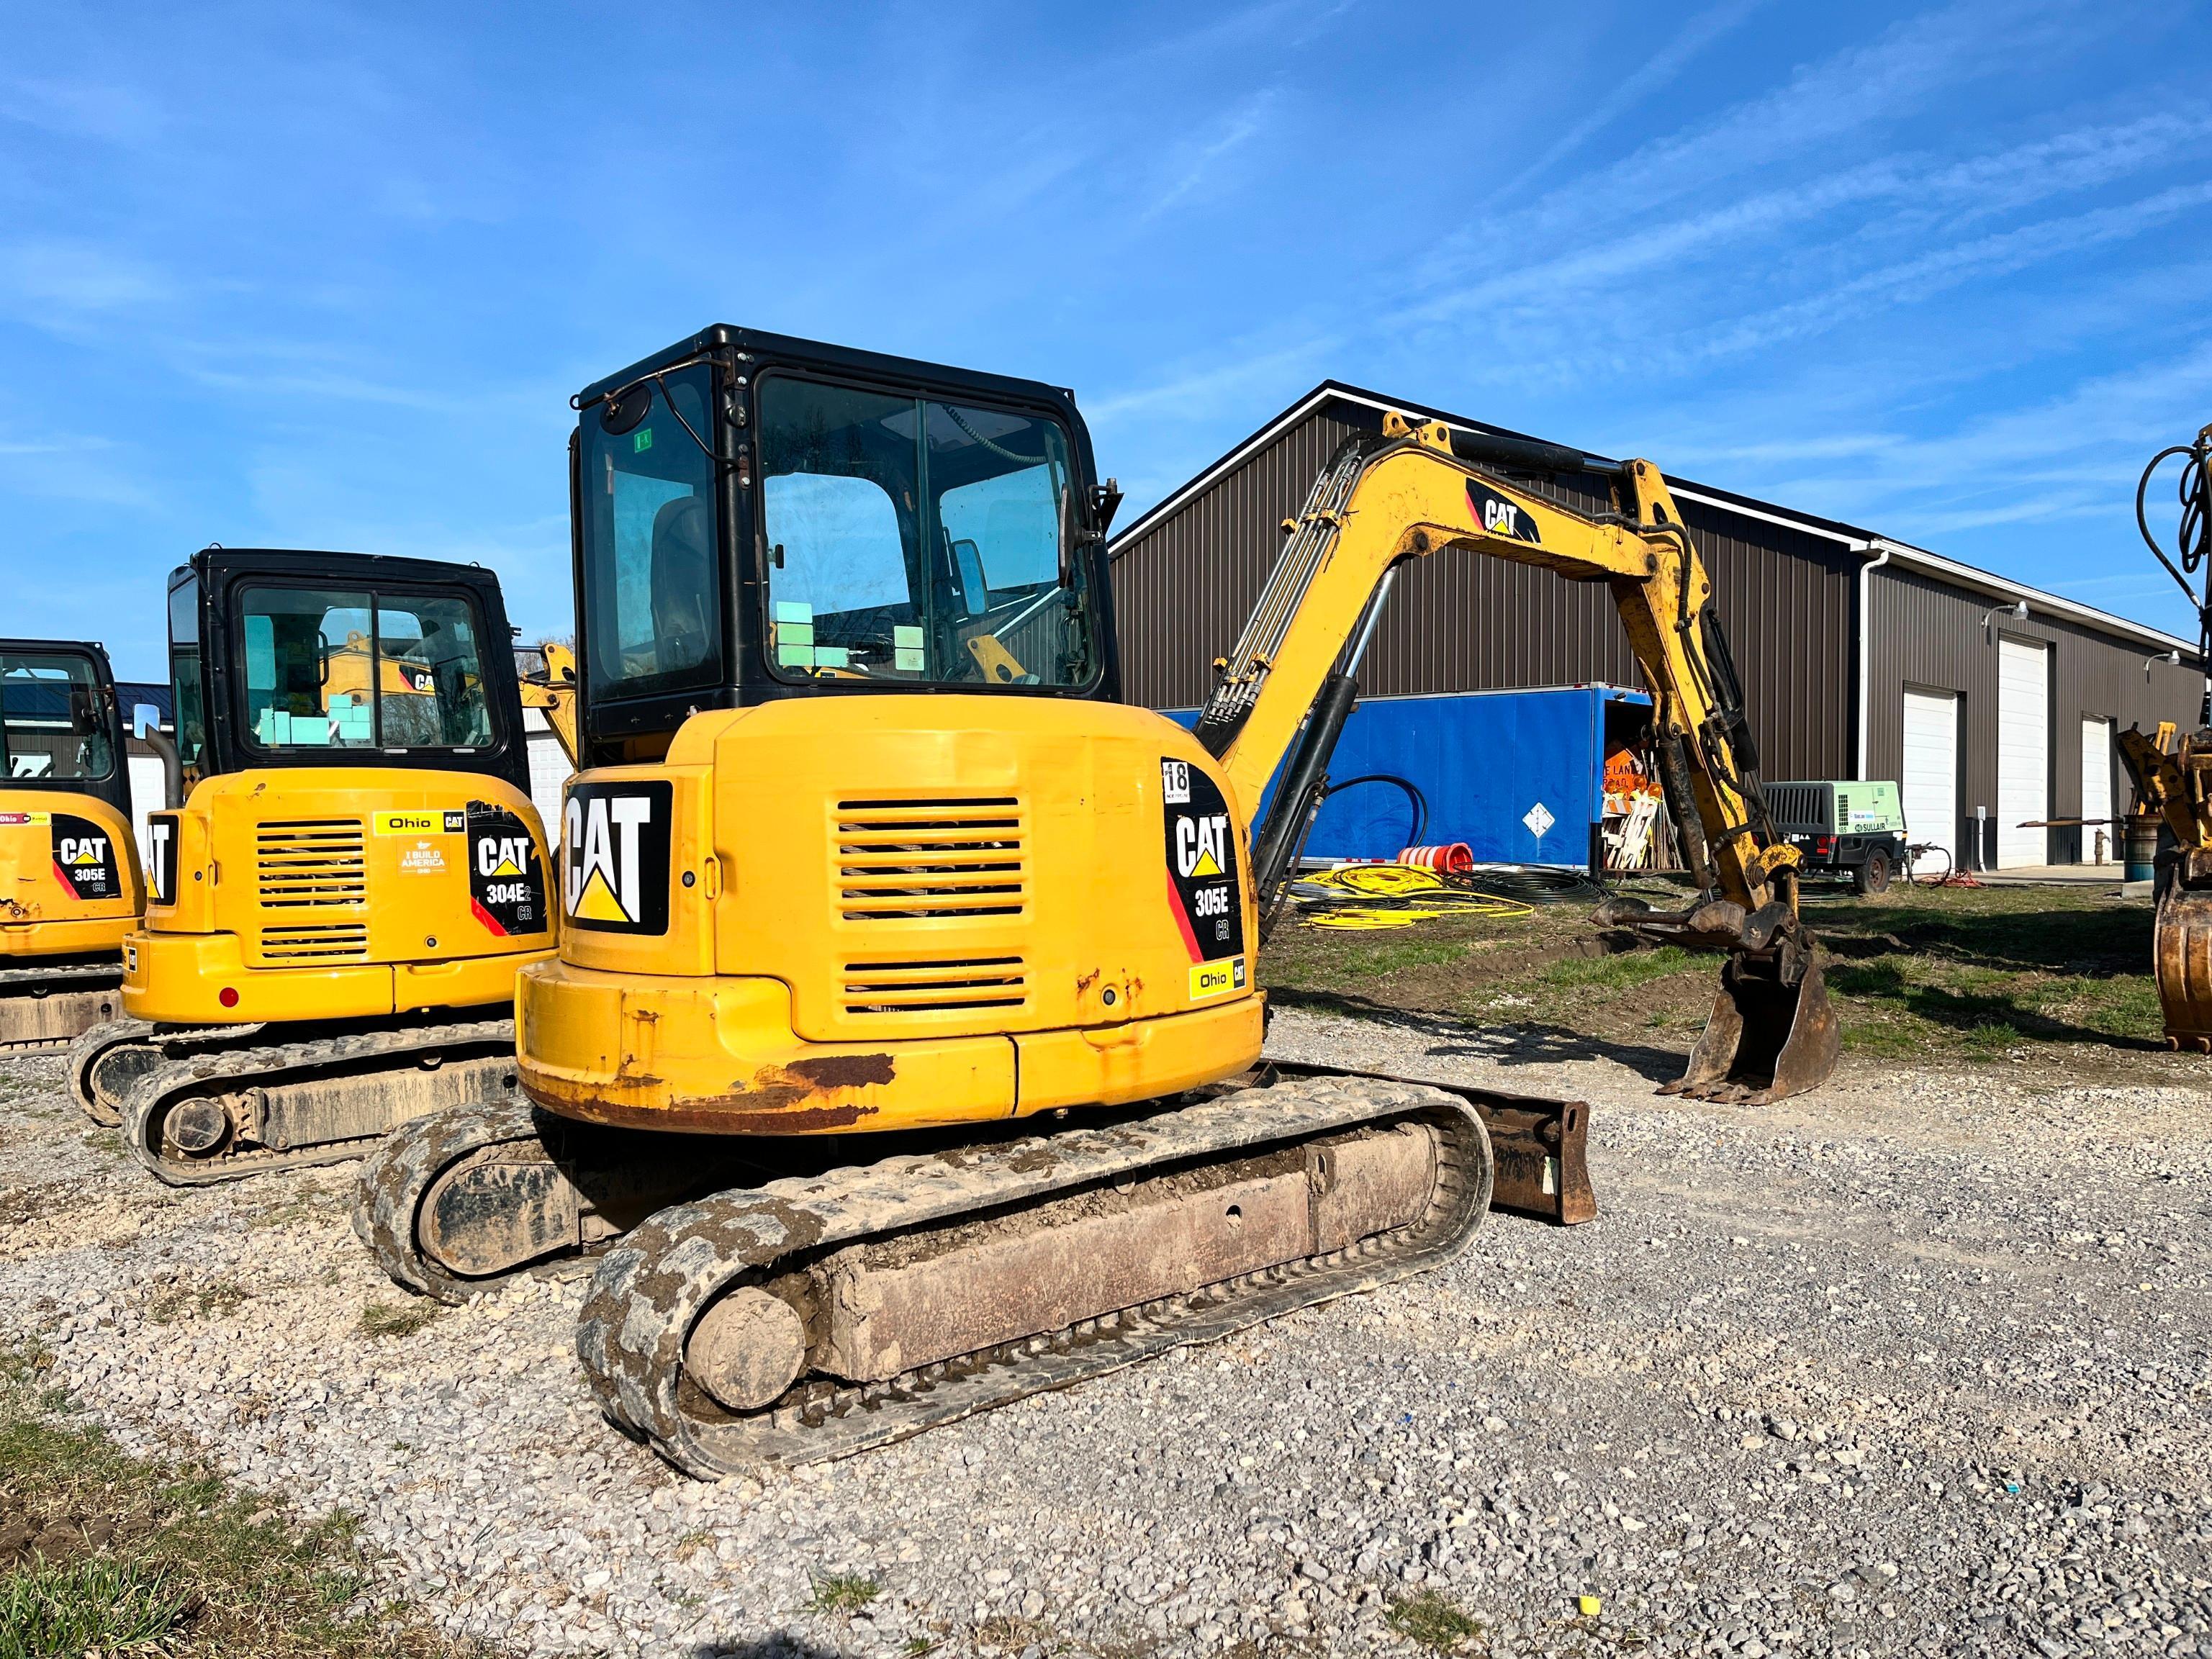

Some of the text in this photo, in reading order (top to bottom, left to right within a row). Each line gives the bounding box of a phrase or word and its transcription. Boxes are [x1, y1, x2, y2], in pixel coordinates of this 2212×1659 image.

[1485, 499, 1517, 535] CAT
[415, 674, 435, 690] CA
[1165, 764, 1187, 790] 18
[389, 816, 463, 828] Ohio CAT
[1863, 823, 1886, 832] SULLAIR
[60, 838, 107, 864] CAT
[412, 850, 441, 859] BUILD
[478, 837, 529, 877] CAT
[1175, 816, 1227, 878] CAT
[148, 825, 169, 899] AT
[402, 858, 446, 867] AMERICA
[565, 797, 651, 923] CAT
[75, 868, 106, 882] 305E
[92, 882, 106, 892] CR
[1195, 886, 1229, 917] 305E
[517, 906, 532, 921] CR
[1215, 919, 1229, 941] CR
[1200, 965, 1244, 988] Ohio CAT
